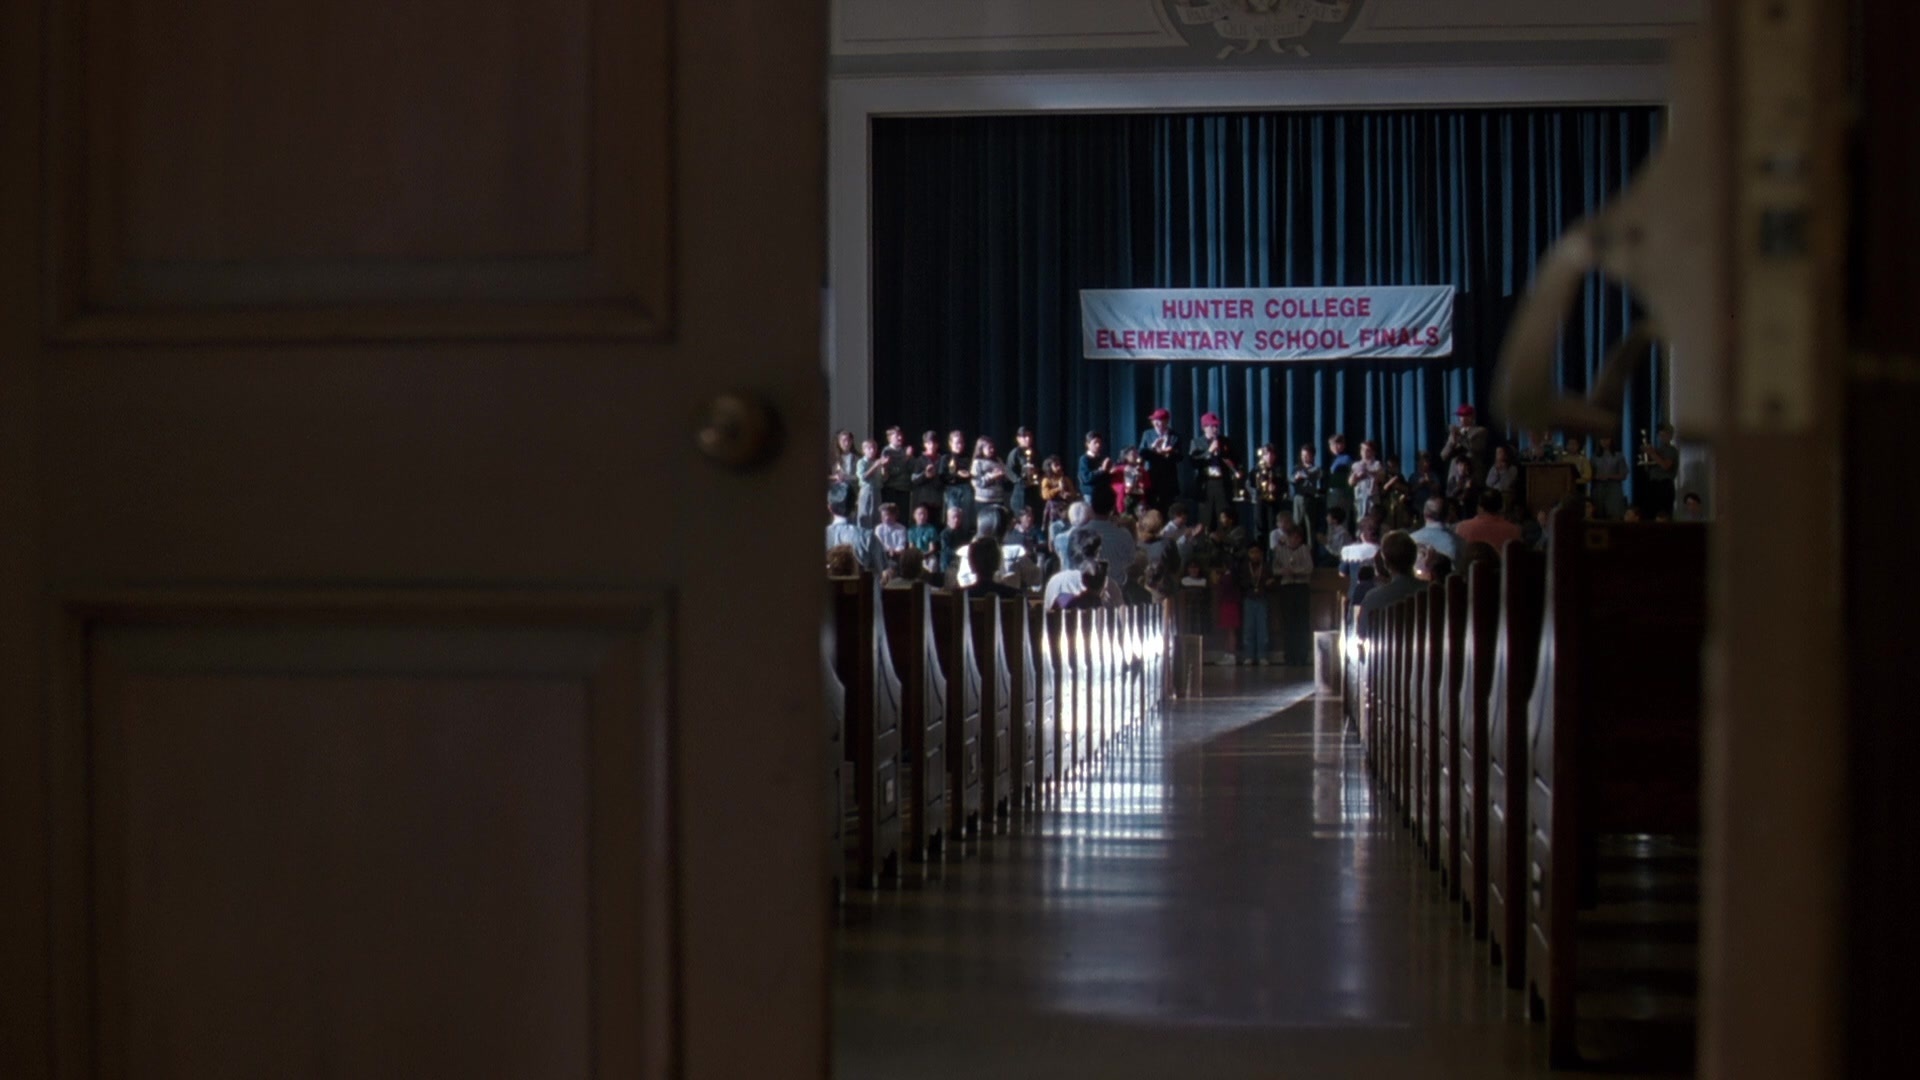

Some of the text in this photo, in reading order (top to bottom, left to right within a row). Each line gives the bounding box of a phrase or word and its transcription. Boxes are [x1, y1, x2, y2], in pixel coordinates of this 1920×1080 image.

[1162, 297, 1371, 319] HUNTER COLLEGE
[1096, 326, 1440, 350] ELEMENTARY SCHOOL FINALS
